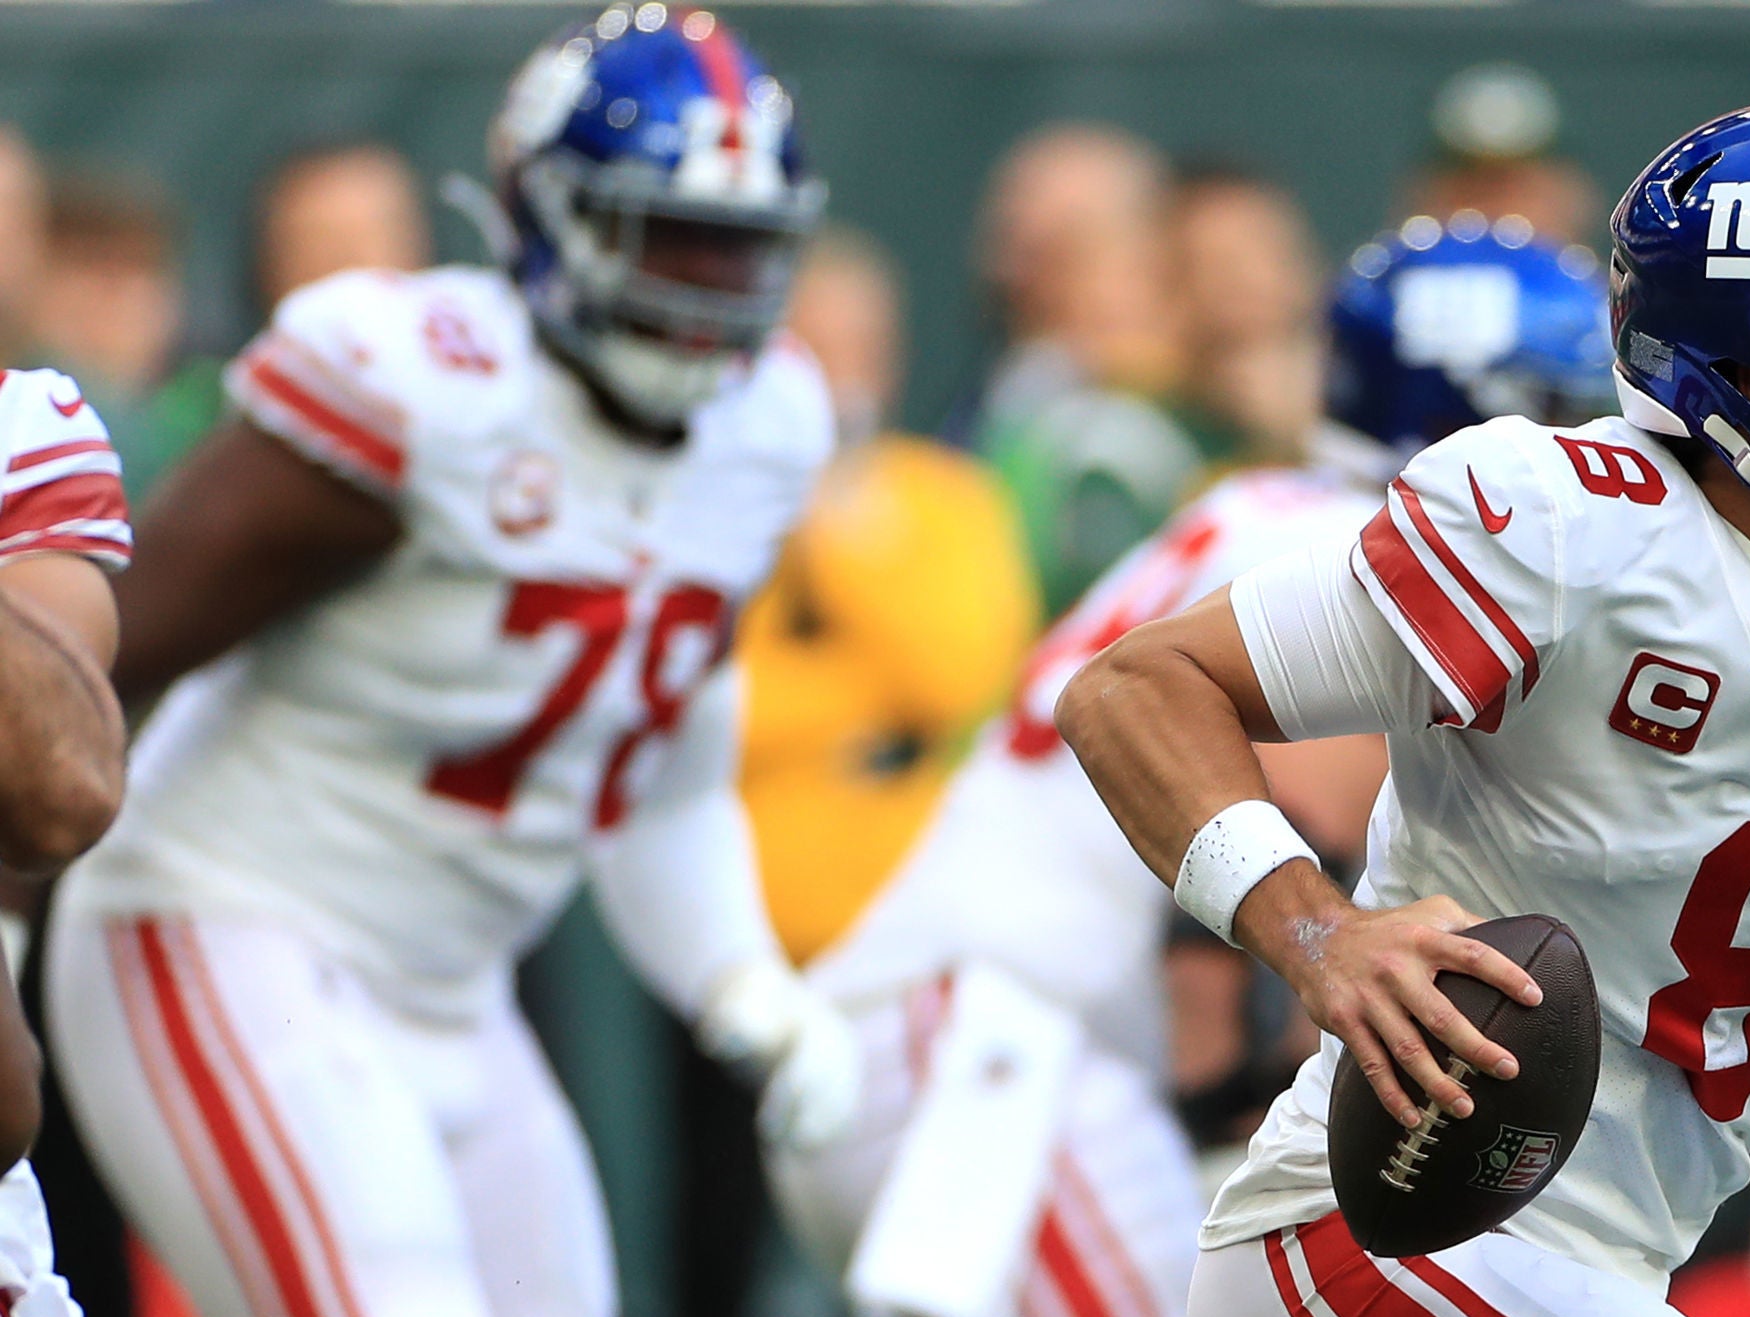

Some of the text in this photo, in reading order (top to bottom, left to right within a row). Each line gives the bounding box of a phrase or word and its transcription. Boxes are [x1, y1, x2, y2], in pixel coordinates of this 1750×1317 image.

[1553, 434, 1668, 506] 8
[423, 578, 735, 833] 78
[1627, 663, 1710, 730] C
[1499, 1139, 1555, 1187] NFL
